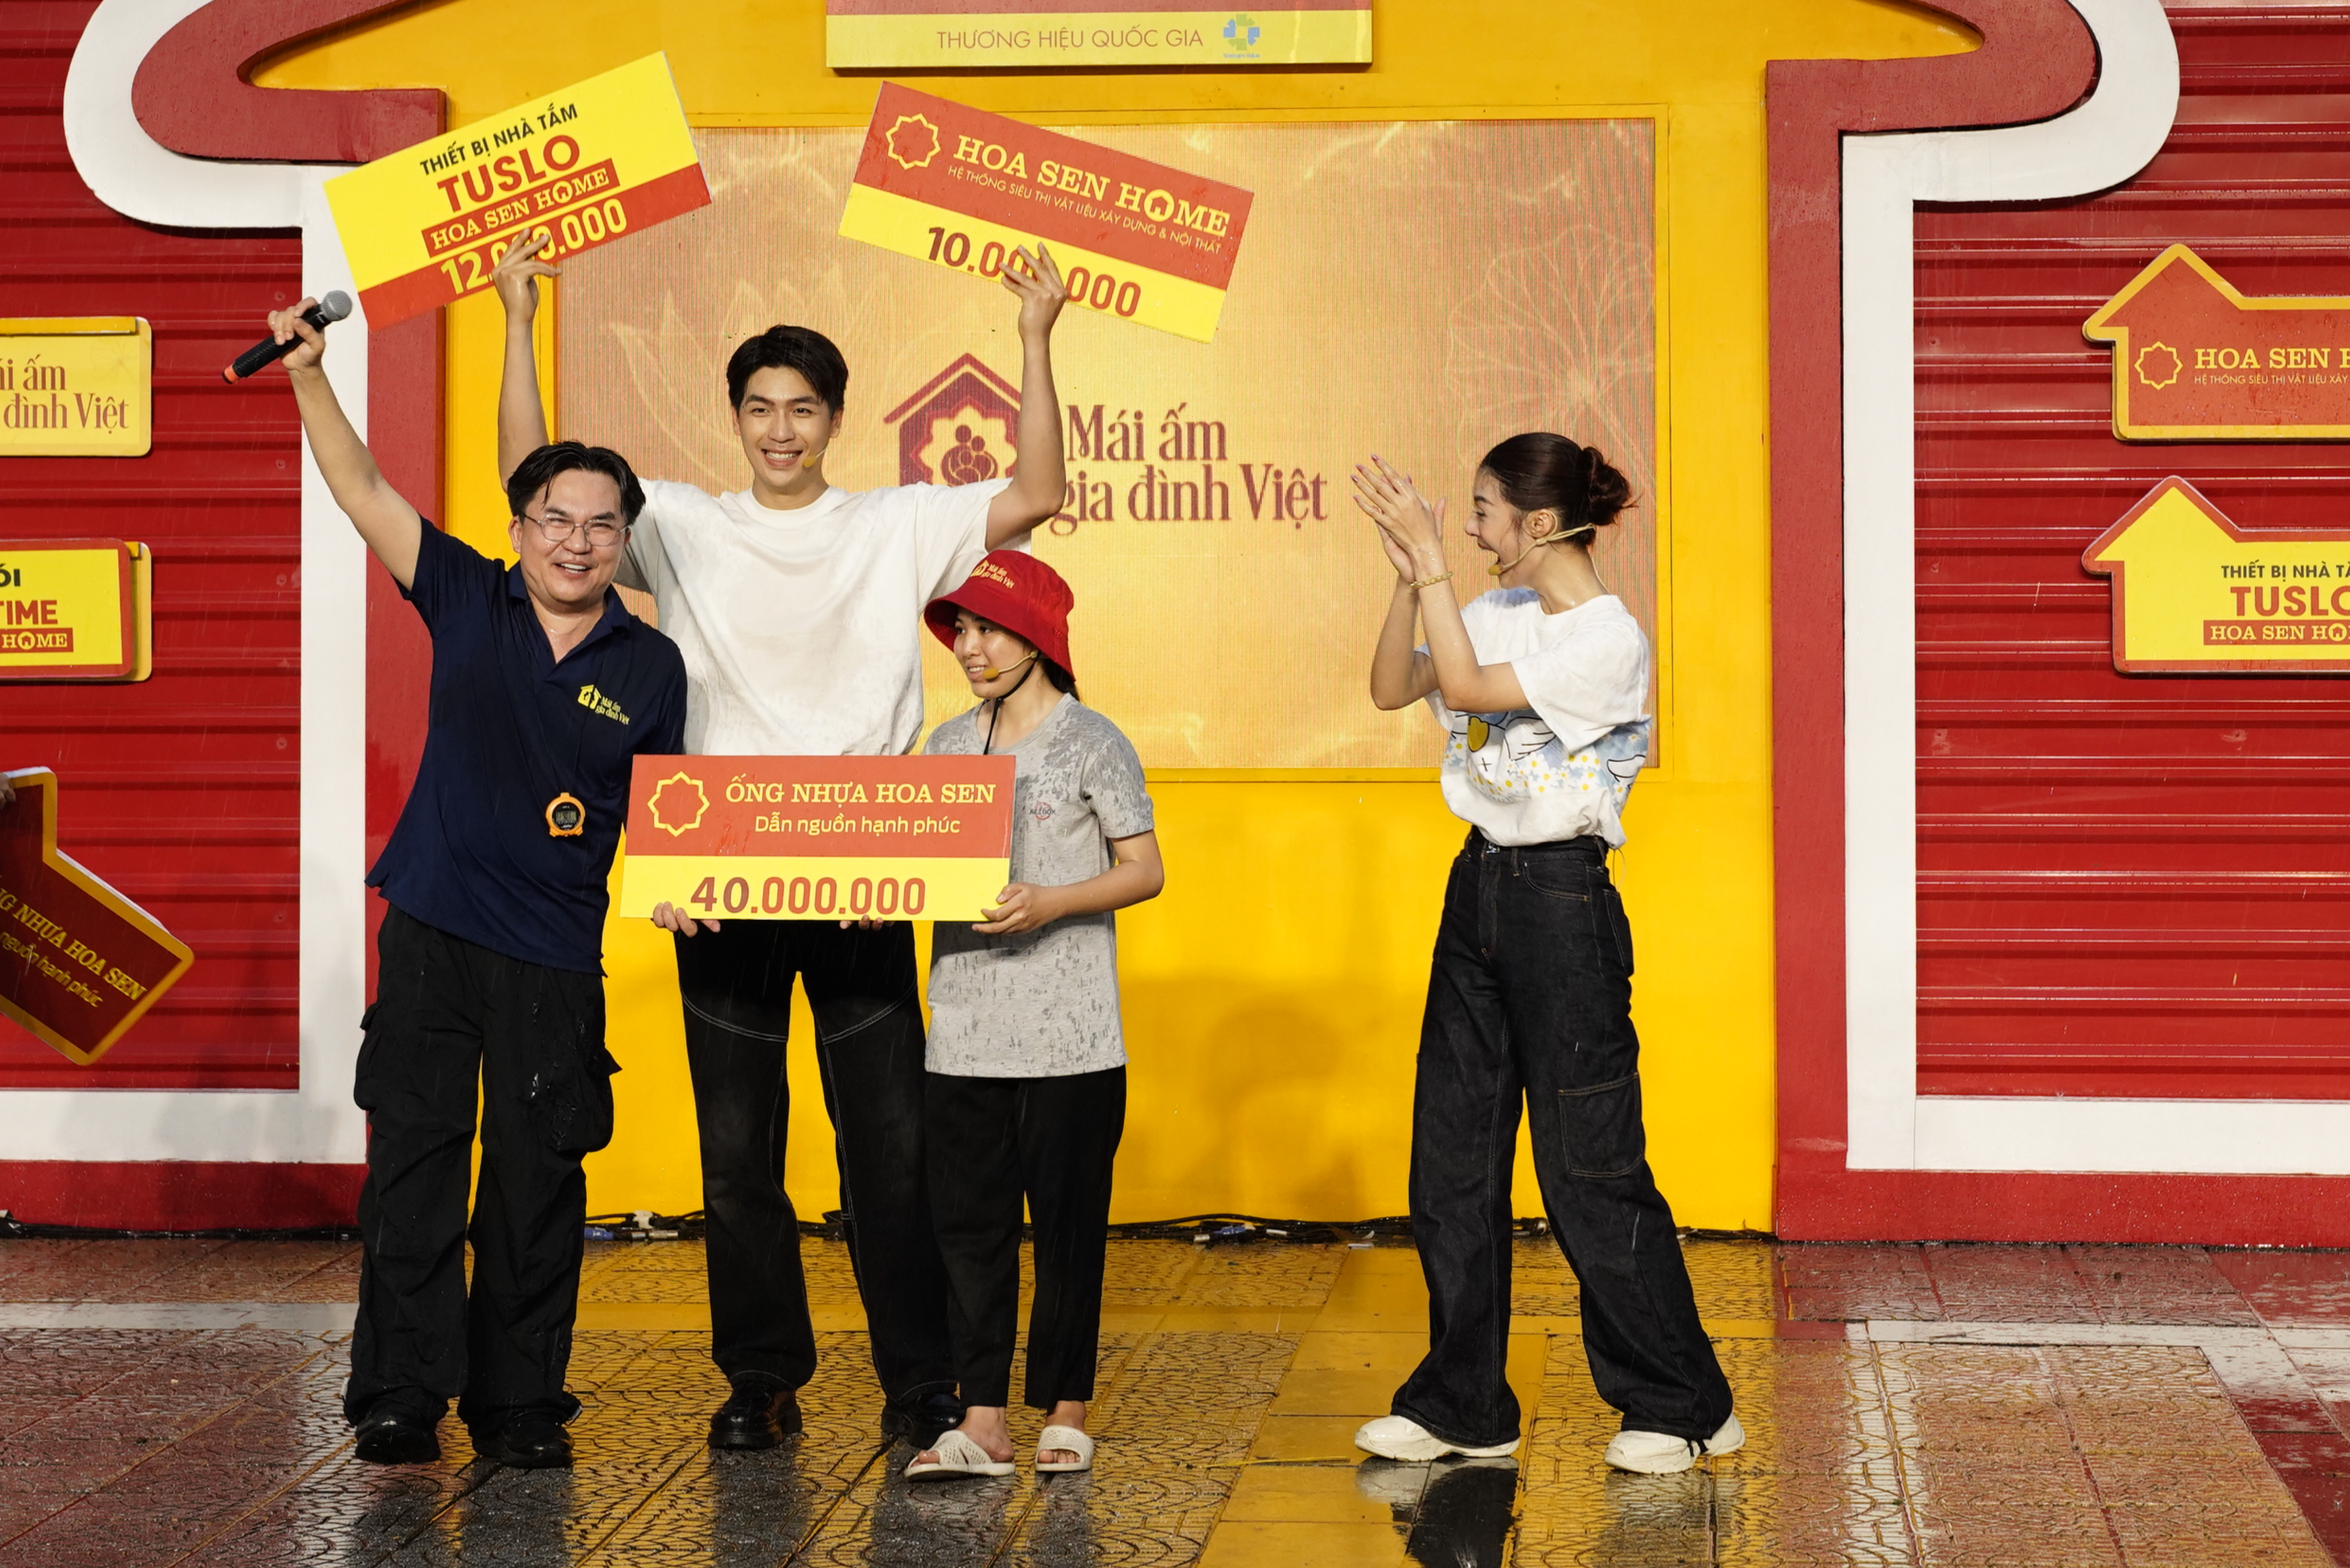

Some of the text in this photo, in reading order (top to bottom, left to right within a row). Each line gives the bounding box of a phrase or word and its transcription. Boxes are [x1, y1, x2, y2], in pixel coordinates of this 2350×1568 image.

[937, 24, 1203, 51] THƯƠNG HIỆU QUỐC GIA
[420, 103, 578, 176] THIẾT BỊ NHÀ TẮM
[437, 135, 580, 213] TUSLO
[953, 135, 1230, 238] HOA SEN HOME
[431, 168, 610, 250] HOA SEN HOME
[948, 165, 1222, 255] HỆ THỐNG SIÊU THỊ VẬT LIỆU XÂY DỤNG & NỘI THẤT
[23, 354, 67, 391] ấm
[2194, 348, 2261, 369] HOA
[2270, 347, 2331, 368] SEN
[2194, 372, 2348, 386] HỆ THỐNG SIÊU THỊ VẬT LIỆU XÂY
[3, 392, 129, 435] đình Việt
[1067, 402, 1228, 462] Mái ấm
[1049, 463, 1328, 536] gia đình Việt
[2221, 559, 2265, 578] THIẾT
[2271, 565, 2287, 582] BỊ
[2293, 561, 2330, 578] NHÀ
[0, 600, 58, 625] IME
[2230, 585, 2350, 617] TUSLO
[2, 631, 67, 650] HOME
[2210, 623, 2350, 642] HOA SEN HO
[725, 773, 996, 808] ỐNG NHỰA HOA SEN
[755, 811, 961, 837] Dẫn nguồn hạnh phúc
[690, 876, 926, 915] 40.000.000
[12, 903, 68, 949] NHỰA
[64, 939, 107, 976] HOA
[102, 967, 148, 1001] SEN
[35, 955, 71, 986] hạnh
[66, 982, 104, 1008] phúc
